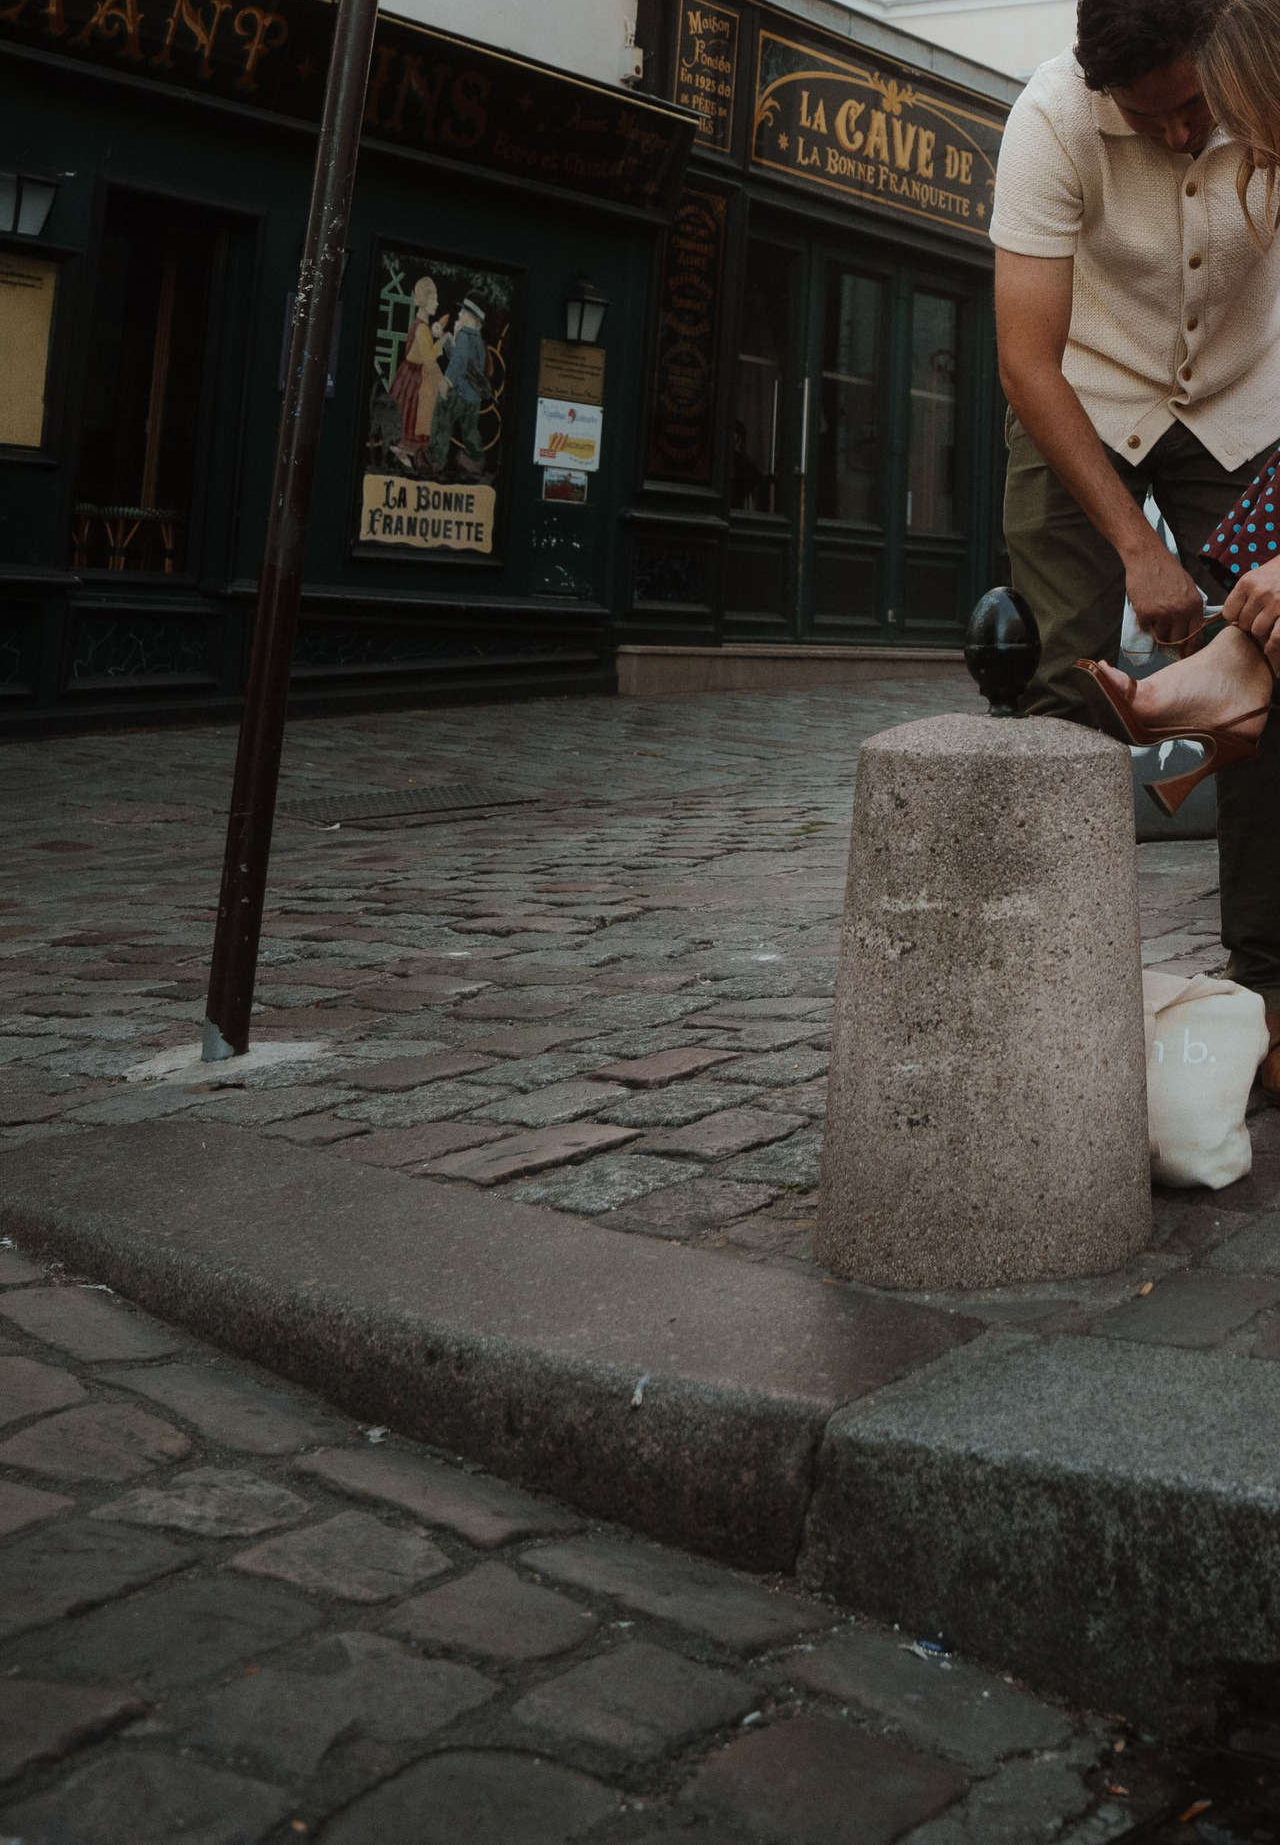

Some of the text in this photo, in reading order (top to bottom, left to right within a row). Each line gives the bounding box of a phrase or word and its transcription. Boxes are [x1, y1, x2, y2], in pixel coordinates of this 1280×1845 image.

[687, 10, 730, 39] Maison
[682, 36, 731, 74] Fondée
[361, 43, 495, 147] INS
[680, 66, 731, 98] En 1925 de
[698, 116, 714, 136] ILS
[799, 90, 974, 186] LA CAVE DE
[796, 136, 970, 218] LA BONNE FRANQUETTE
[381, 479, 475, 514] LA BONNE
[366, 507, 485, 543] FRANQUETTE
